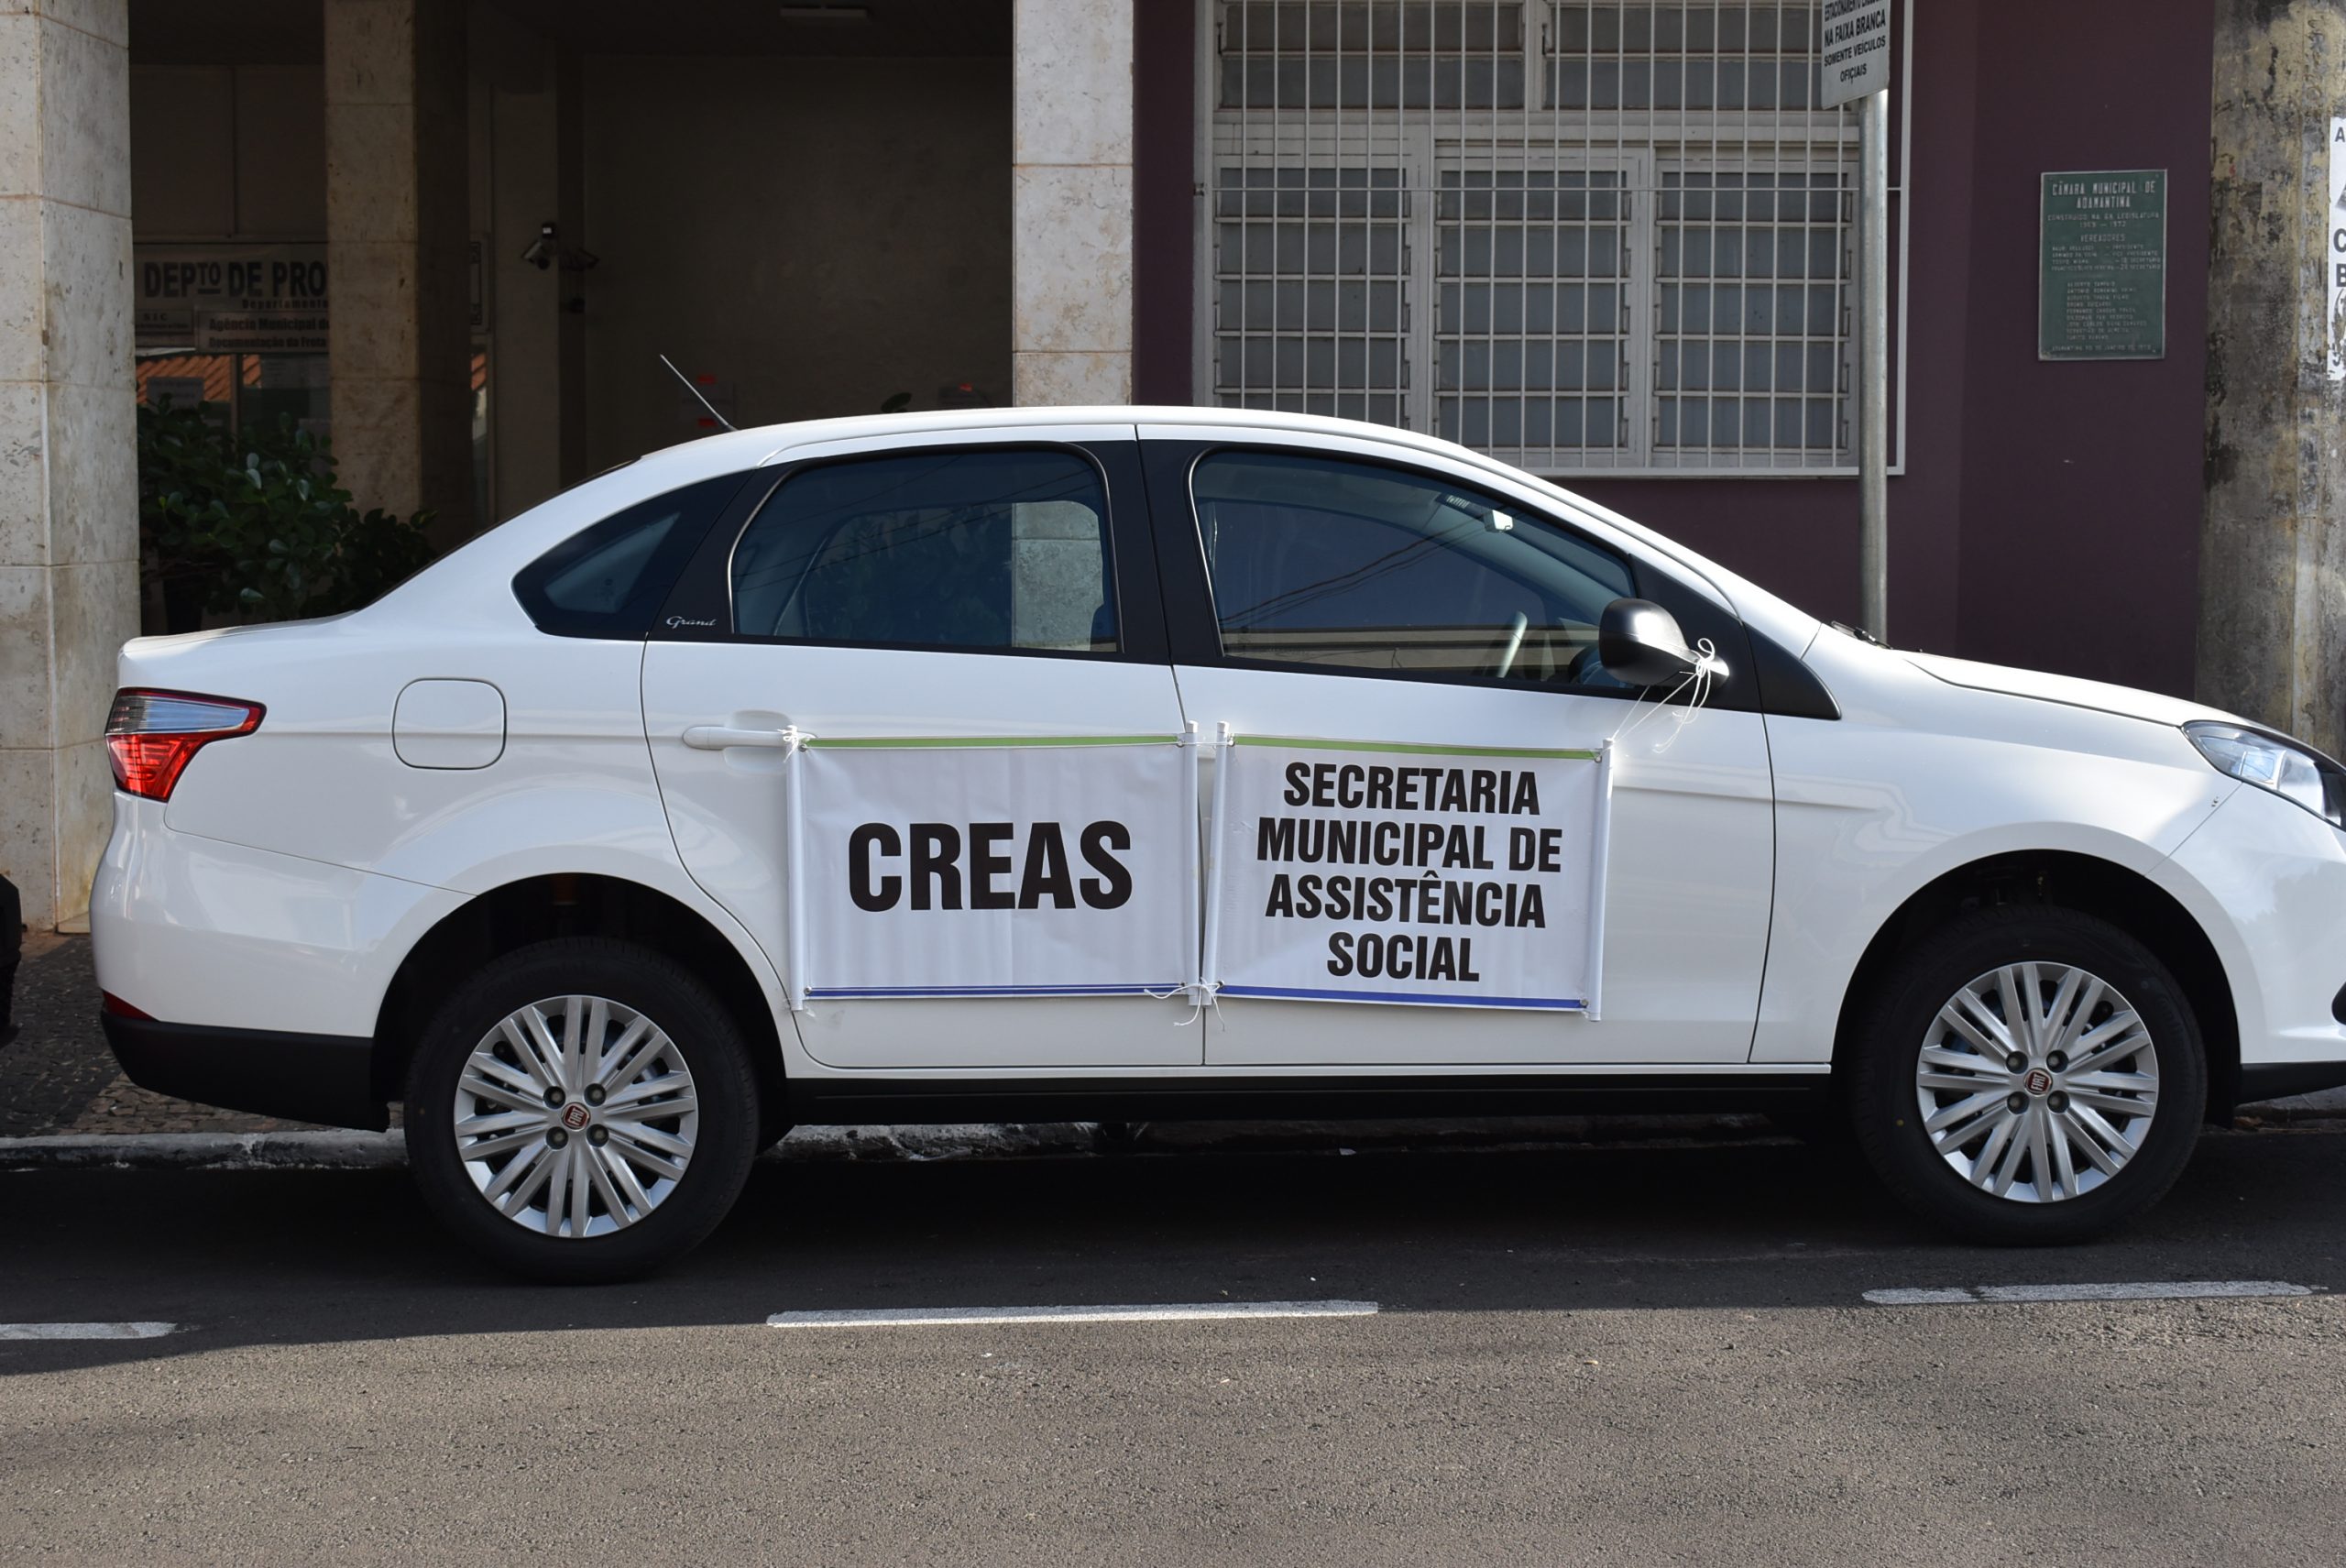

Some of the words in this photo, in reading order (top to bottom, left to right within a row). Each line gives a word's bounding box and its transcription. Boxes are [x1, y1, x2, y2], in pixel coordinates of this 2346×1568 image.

[1825, 28, 1834, 48] NA
[1835, 20, 1855, 44] FAIXA
[1856, 9, 1886, 37] BRANCA
[1824, 47, 1853, 67] SOMENTE
[1854, 35, 1886, 57] VEÍCULOS
[2052, 181, 2085, 196] CÂMARA
[2092, 181, 2137, 194] MUNICIPAL
[2144, 180, 2156, 193] DE
[2077, 195, 2131, 209] ADAMANTINA
[228, 261, 263, 297] DE
[272, 260, 328, 297] PRO
[209, 317, 256, 332] Agência
[258, 317, 316, 331] Municipal
[665, 615, 717, 629] Grand
[1283, 761, 1541, 816] SECRETARIA
[1256, 816, 1495, 870] MUNICIPAL
[1509, 827, 1562, 873] DE
[847, 819, 1134, 912] CREAS
[1265, 870, 1547, 928] ASSISTÊNCIA
[1327, 932, 1480, 981] SOCIAL
[2031, 1073, 2046, 1091] FIAT
[567, 1107, 585, 1125] FIAT
